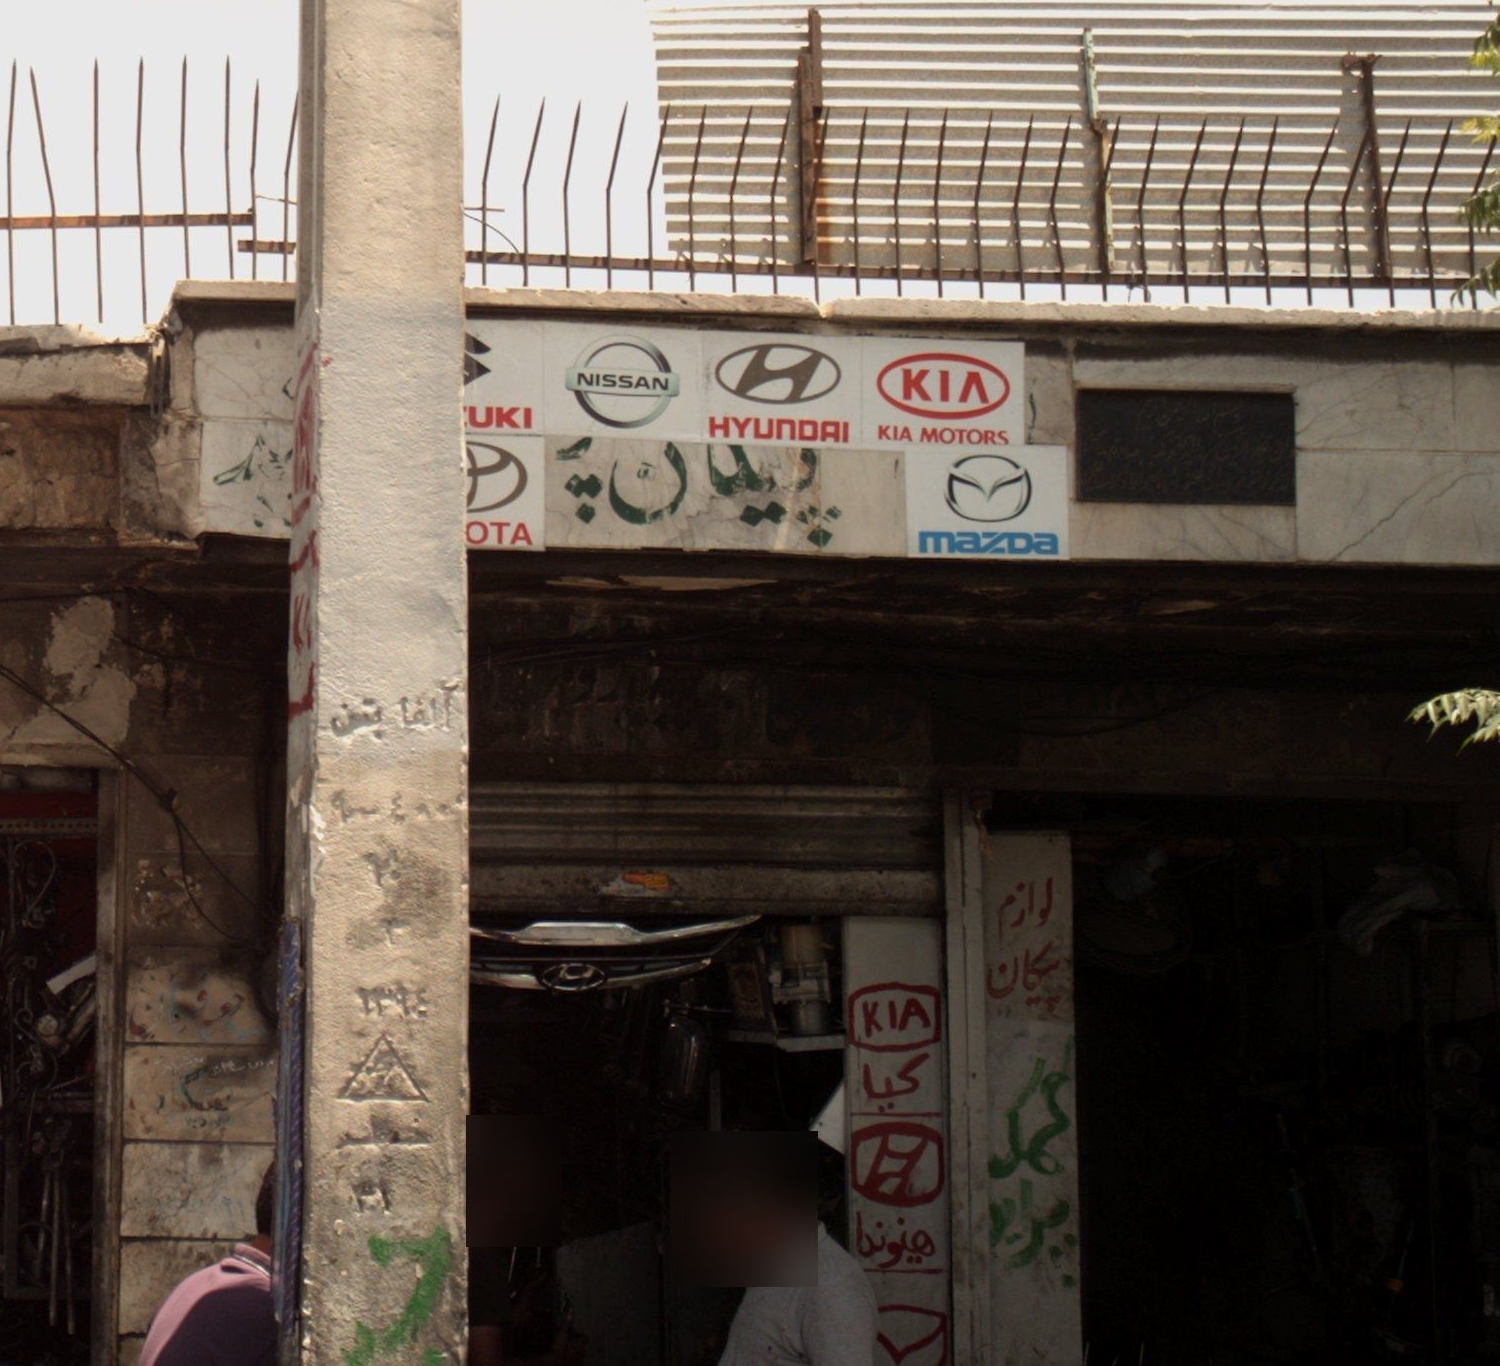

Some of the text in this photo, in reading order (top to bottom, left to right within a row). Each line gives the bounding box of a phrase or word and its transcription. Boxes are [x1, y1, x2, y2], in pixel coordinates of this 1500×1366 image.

[577, 373, 669, 391] NISSAN
[902, 368, 990, 404] KIA
[464, 406, 532, 429] UKI
[708, 416, 849, 443] HYUNDAI
[878, 425, 1009, 445] KIA MOTORS
[466, 521, 532, 545] OTA
[986, 940, 1061, 1017] پیکان
[862, 998, 931, 1038] KIA
[863, 1053, 931, 1113] کیا
